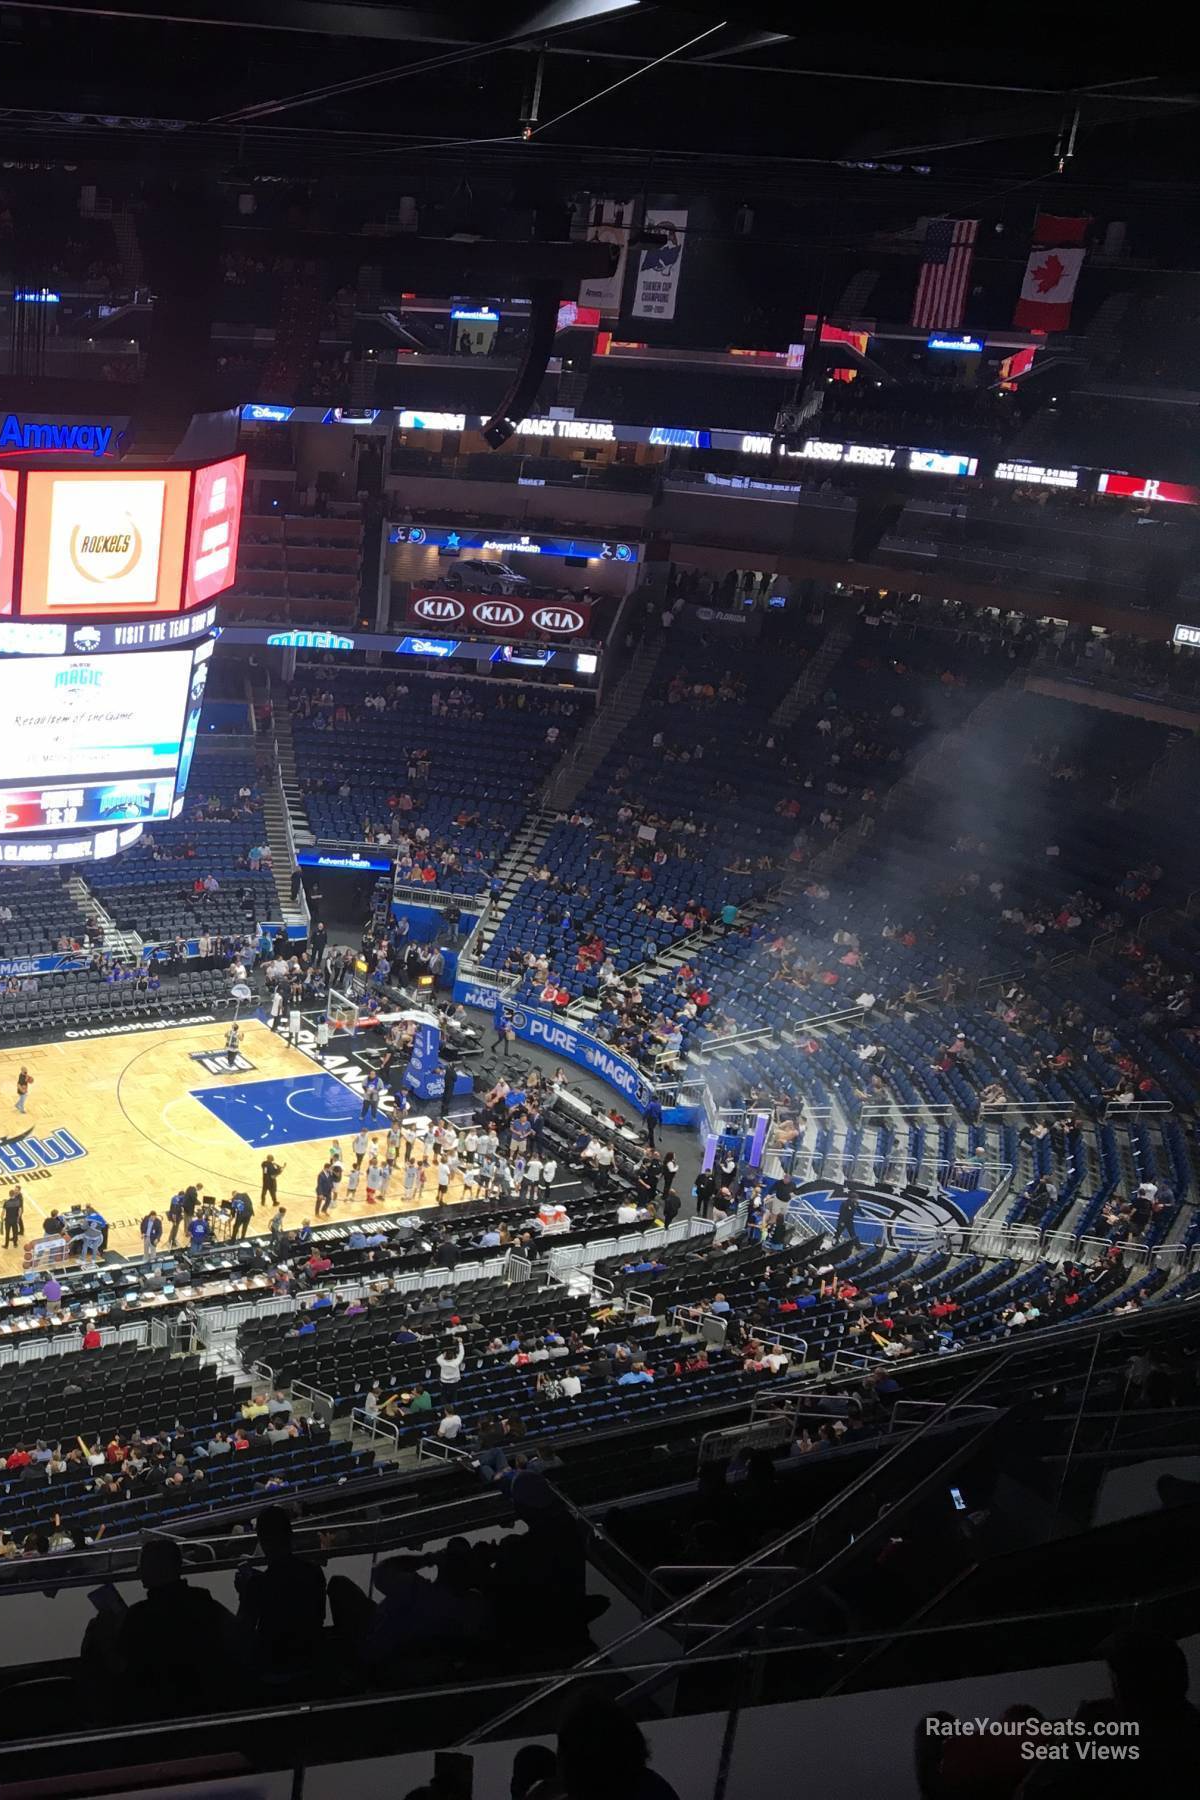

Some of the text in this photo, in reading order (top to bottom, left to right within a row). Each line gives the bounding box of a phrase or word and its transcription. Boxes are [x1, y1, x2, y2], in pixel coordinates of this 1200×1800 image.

[251, 404, 285, 420] Disney
[558, 420, 616, 441] THREADS.
[843, 443, 896, 467] JERSEY.
[483, 539, 541, 554] AdventHealth
[114, 625, 145, 646] VISIT
[149, 622, 166, 642] THE
[169, 618, 191, 639] TEAM
[1177, 627, 1200, 644] BU
[412, 638, 449, 656] Disney
[54, 668, 103, 688] MAGIC
[318, 856, 371, 868] AdventHealth
[0, 960, 41, 976] MAGIC
[464, 992, 498, 1010] MAGI
[64, 1012, 216, 1039] OrlandoMagic.com
[267, 1015, 411, 1114] ORLANO
[529, 1020, 578, 1053] PURE
[592, 1052, 634, 1094] MAGIC
